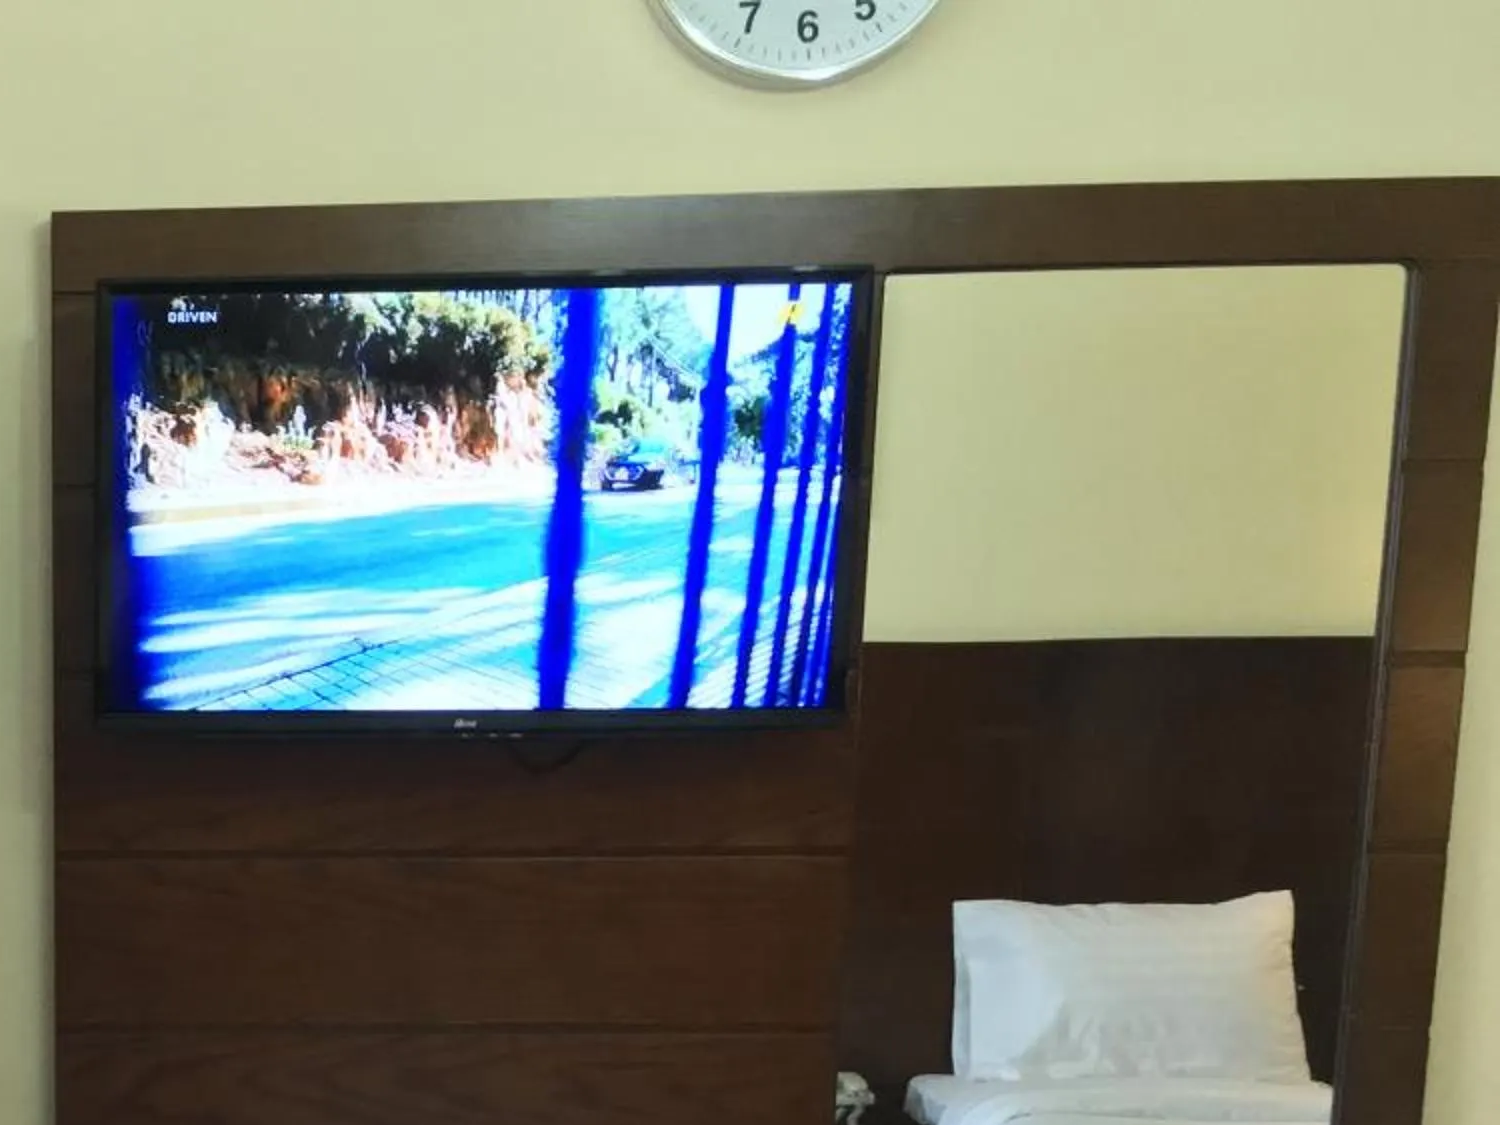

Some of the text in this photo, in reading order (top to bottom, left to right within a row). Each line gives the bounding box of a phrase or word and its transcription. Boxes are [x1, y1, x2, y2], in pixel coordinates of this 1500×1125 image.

[739, 1, 761, 34] 7
[854, 0, 876, 21] 5
[797, 10, 819, 43] 6
[167, 311, 218, 323] DRIVEN
